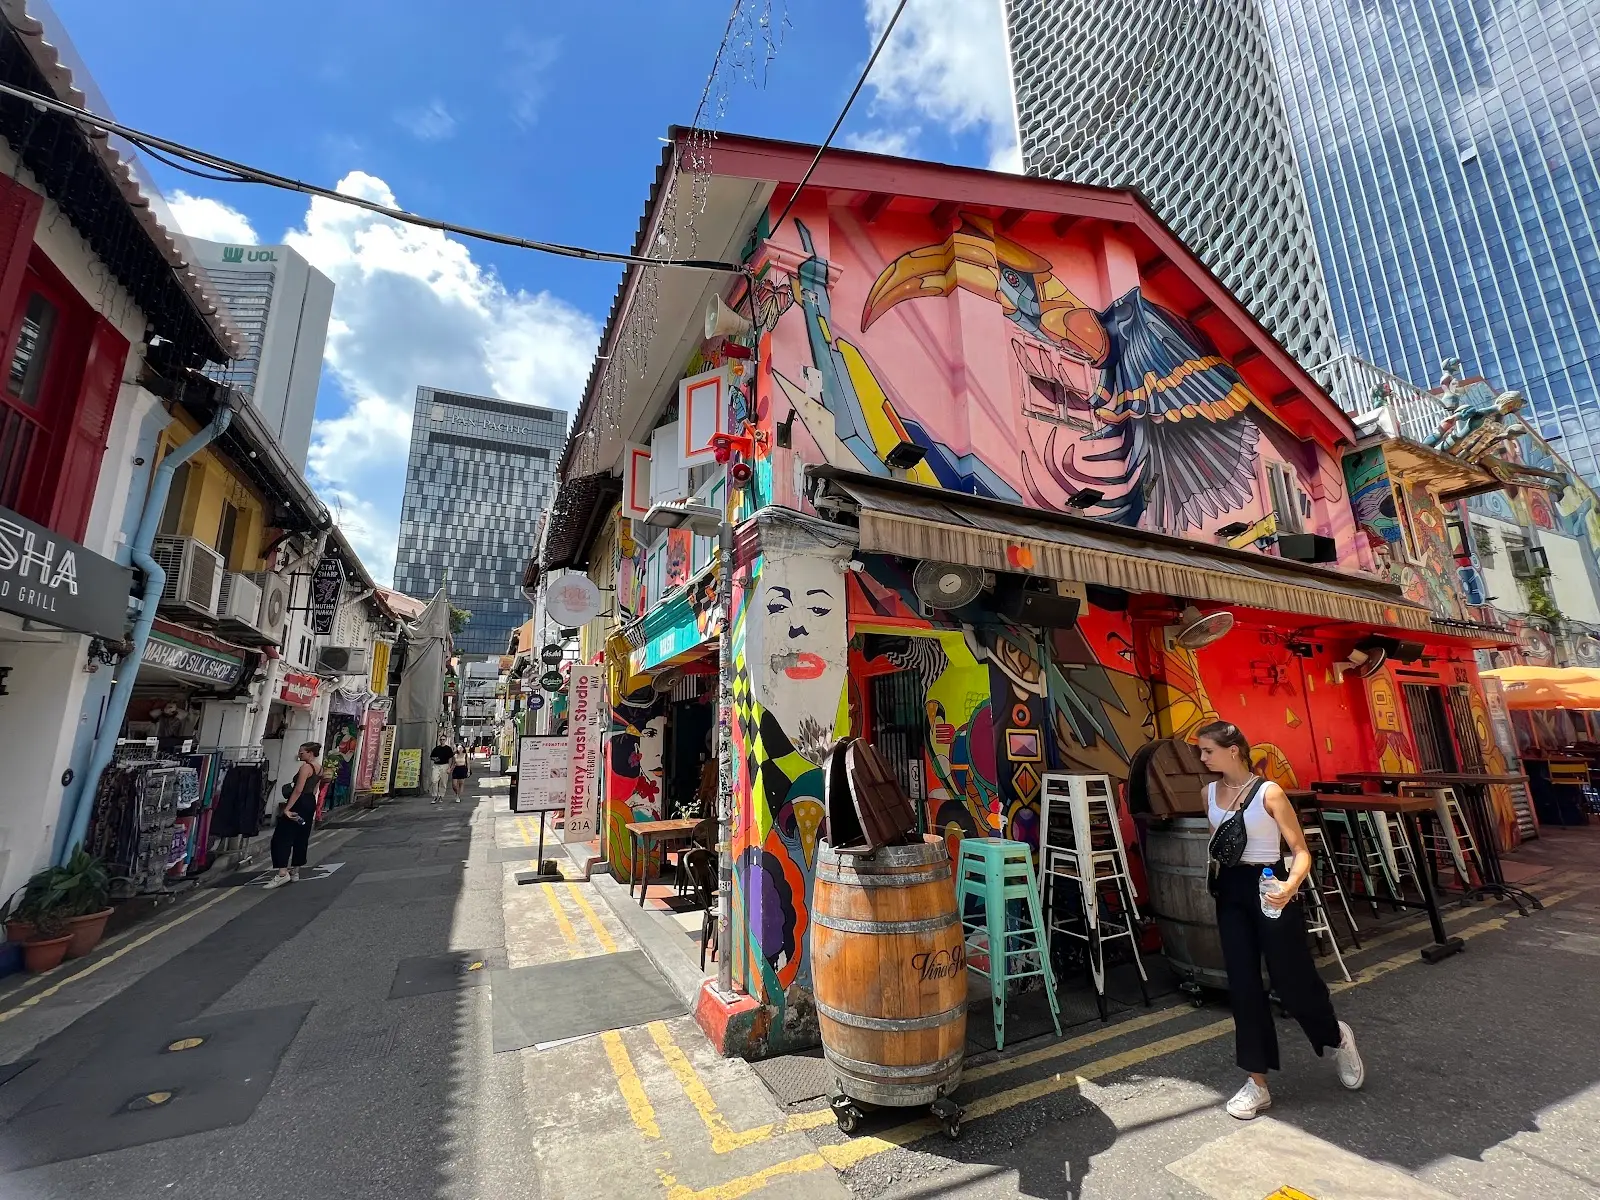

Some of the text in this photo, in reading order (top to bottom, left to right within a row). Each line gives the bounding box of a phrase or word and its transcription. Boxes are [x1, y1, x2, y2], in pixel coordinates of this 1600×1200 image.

[247, 250, 278, 262] UOL
[451, 414, 530, 435] PAN PACIFIC
[18, 586, 56, 612] GRILL
[142, 641, 189, 669] MAHACO
[186, 655, 210, 674] SILK
[206, 661, 231, 679] SHOP
[590, 675, 599, 689] WAX
[570, 675, 589, 818] Tiffany Lash Studio
[379, 757, 390, 781] COTTON
[586, 749, 596, 779] EYEBROW
[571, 820, 590, 831] 21A
